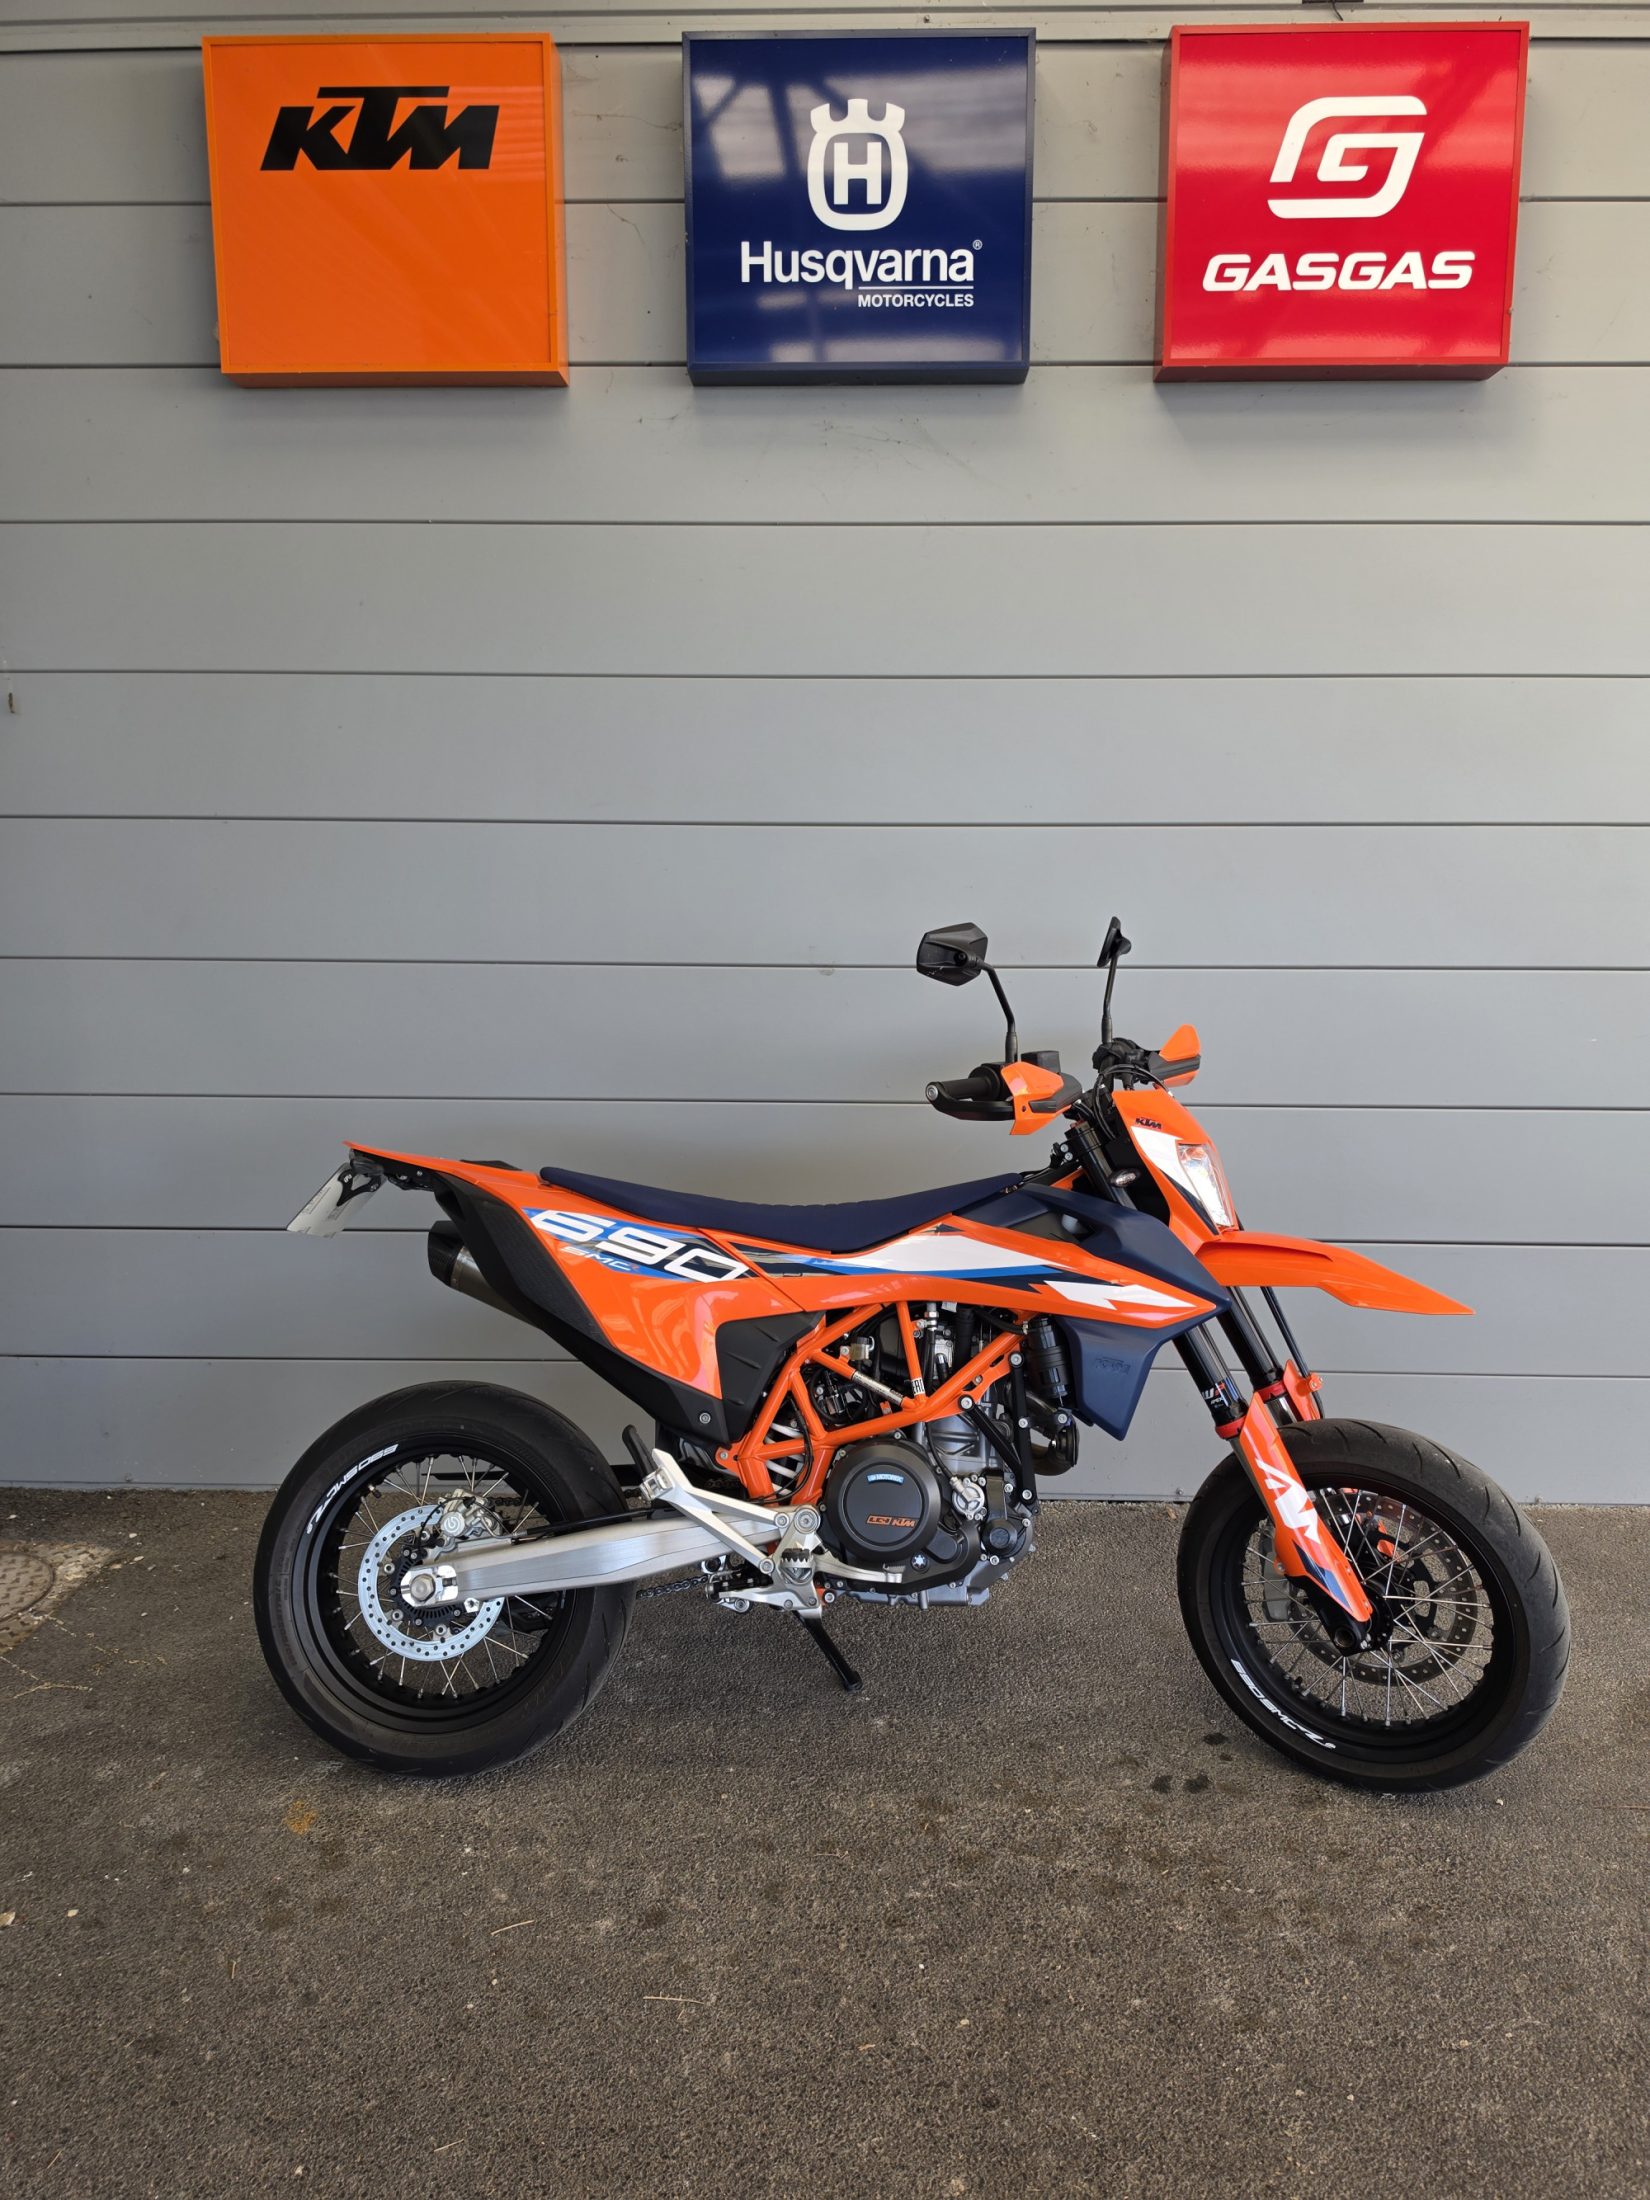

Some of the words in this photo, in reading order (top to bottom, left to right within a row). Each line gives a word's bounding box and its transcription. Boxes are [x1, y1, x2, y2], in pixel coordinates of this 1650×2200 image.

[260, 86, 499, 171] KTM
[1202, 251, 1476, 291] GASGAS
[858, 294, 975, 307] MOTORCYCLES
[530, 1209, 750, 1283] 690
